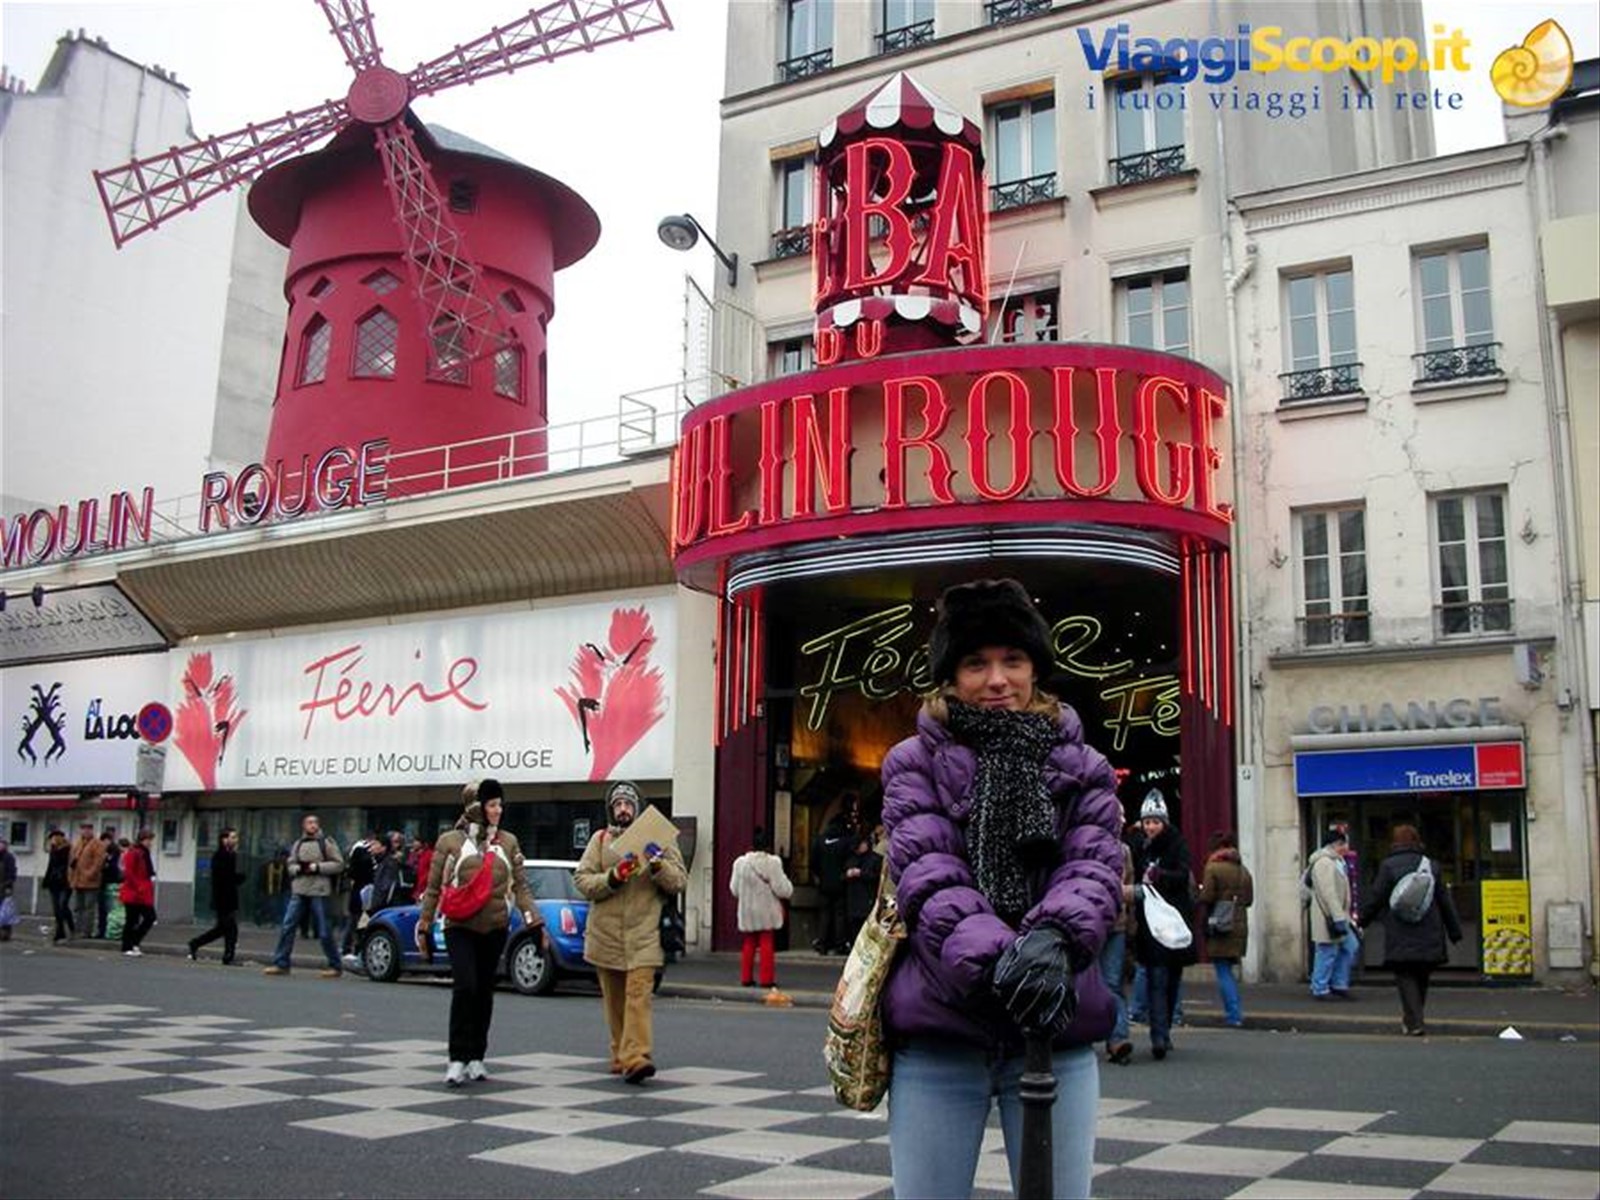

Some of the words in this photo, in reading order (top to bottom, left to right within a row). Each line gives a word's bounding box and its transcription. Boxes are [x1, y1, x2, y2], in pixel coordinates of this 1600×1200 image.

[844, 137, 988, 300] BA
[816, 320, 881, 364] DU
[199, 437, 389, 532] ROUGE
[672, 387, 849, 548] ULIN
[883, 366, 1233, 524] ROUGE
[300, 645, 488, 740] Féerie
[1308, 697, 1502, 735] CHANGE
[84, 716, 105, 740] LA
[1405, 770, 1473, 788] Travelex
